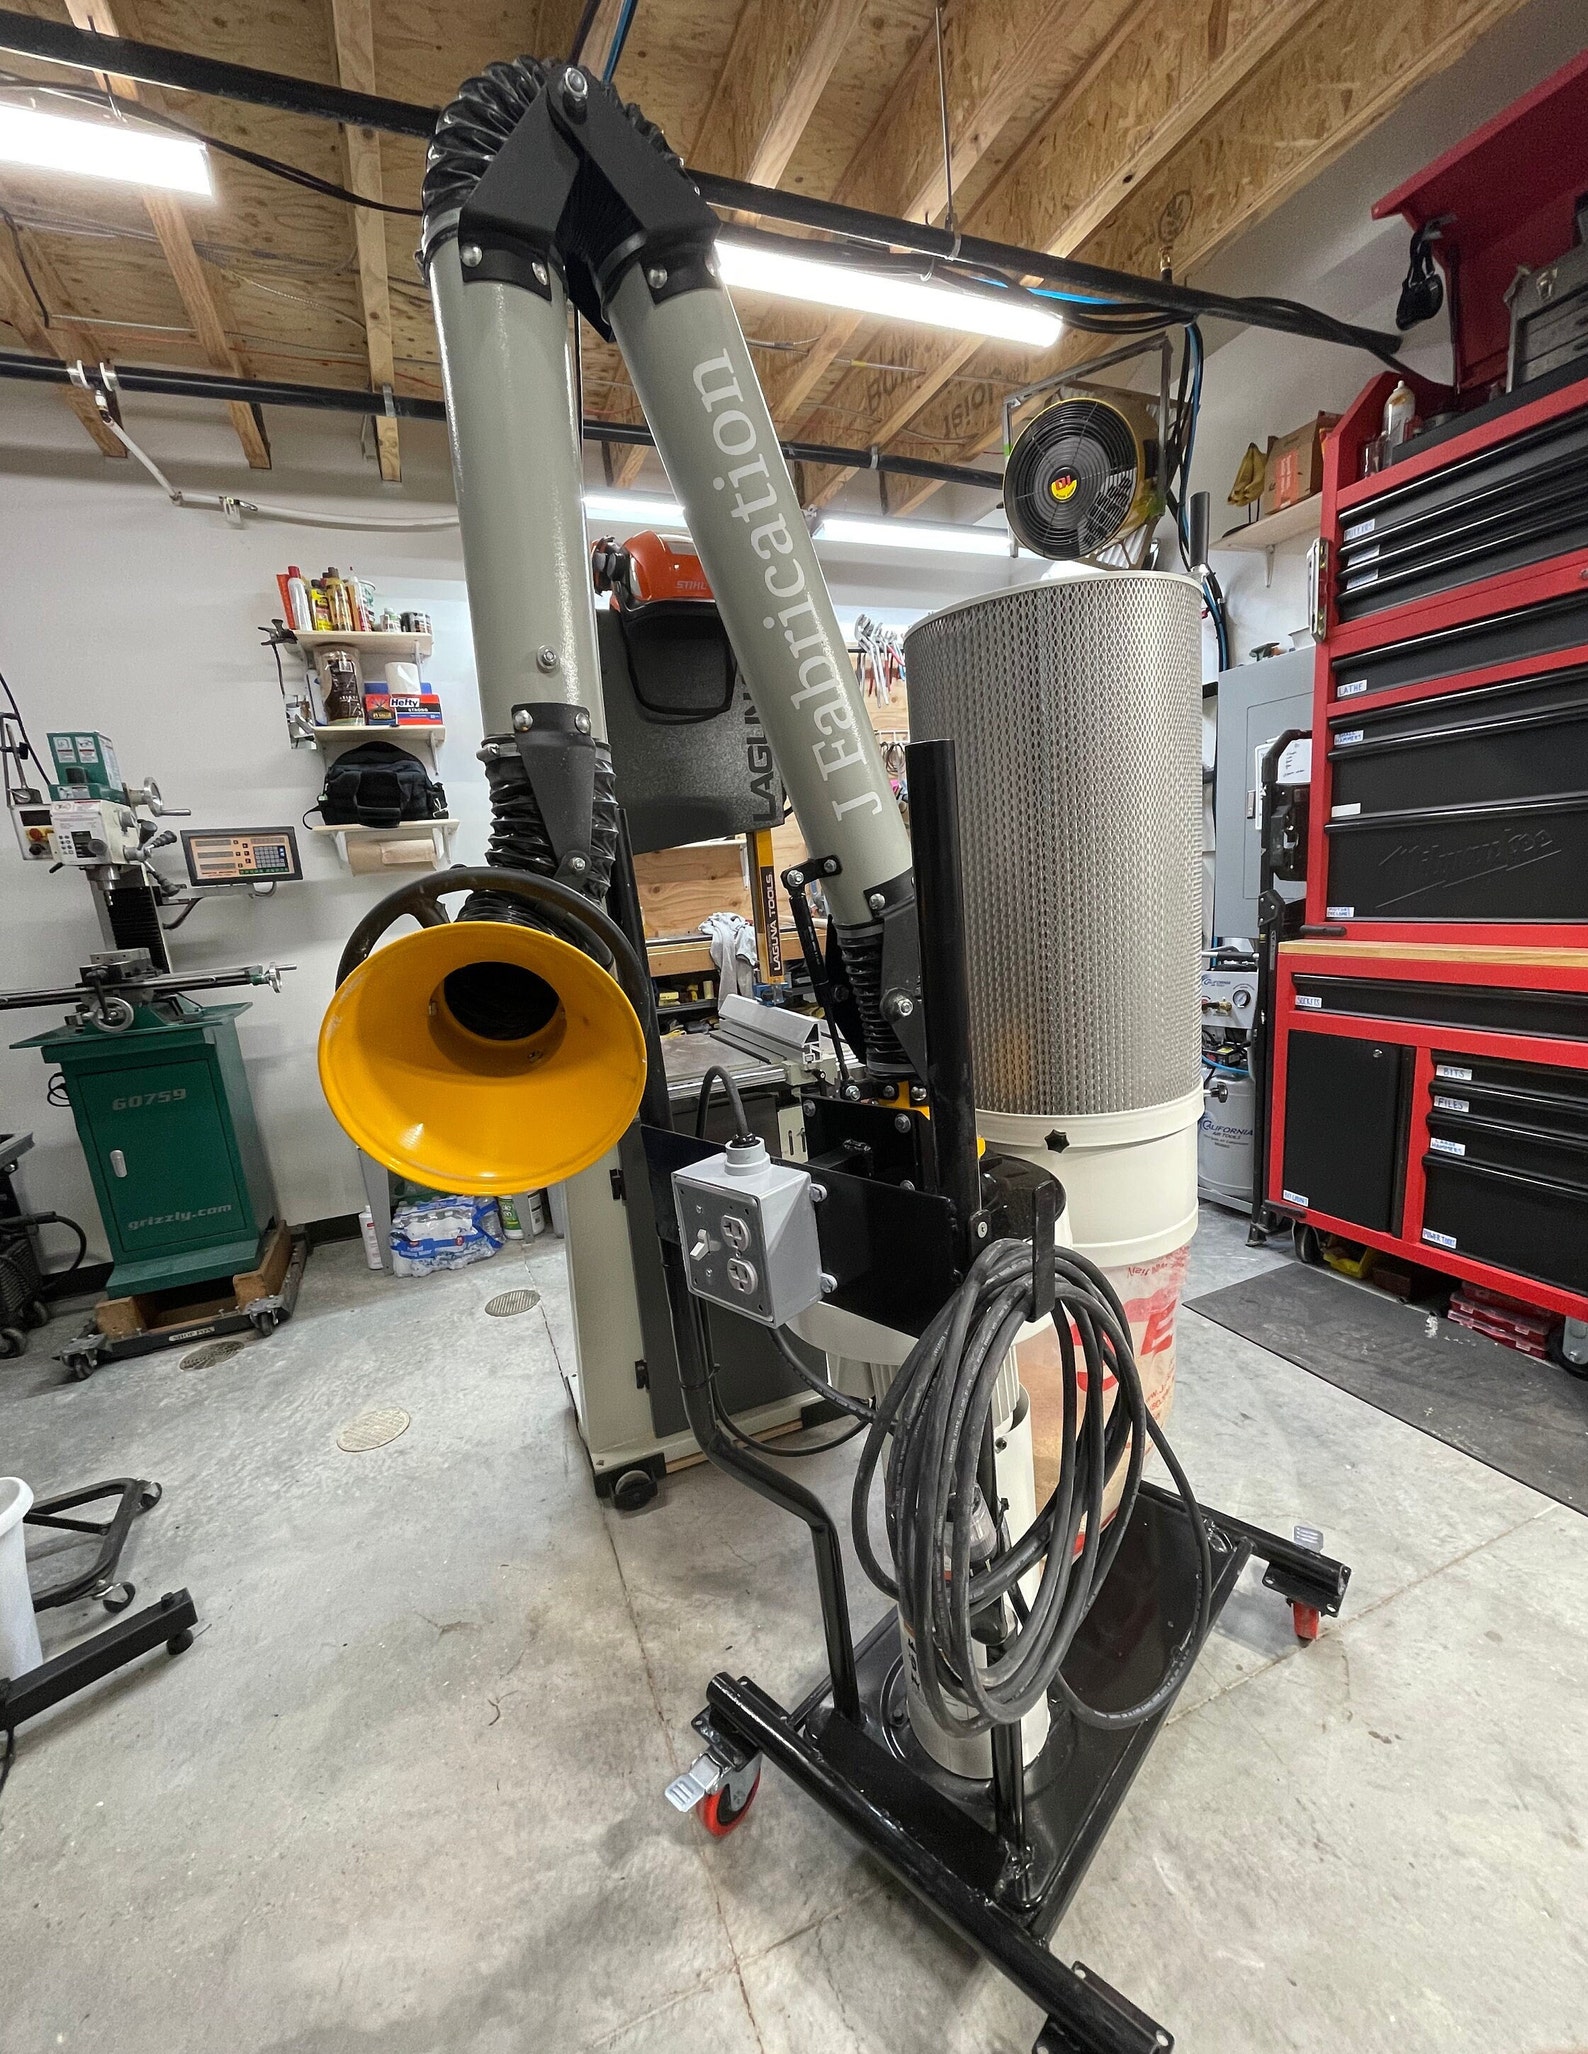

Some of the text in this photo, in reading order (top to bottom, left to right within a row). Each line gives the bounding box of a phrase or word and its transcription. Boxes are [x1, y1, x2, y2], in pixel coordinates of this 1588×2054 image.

[676, 579, 707, 590] STIHL
[692, 347, 883, 822] J Fabrication
[1338, 682, 1364, 696] LATHE
[391, 698, 418, 707] Hefty
[765, 873, 781, 971] LAGUNA TOOLS
[1443, 1067, 1465, 1078] BITS
[1438, 1098, 1463, 1110] FILES
[1203, 1120, 1253, 1136] CALIFORNIA
[128, 1204, 232, 1231] grizzly.com
